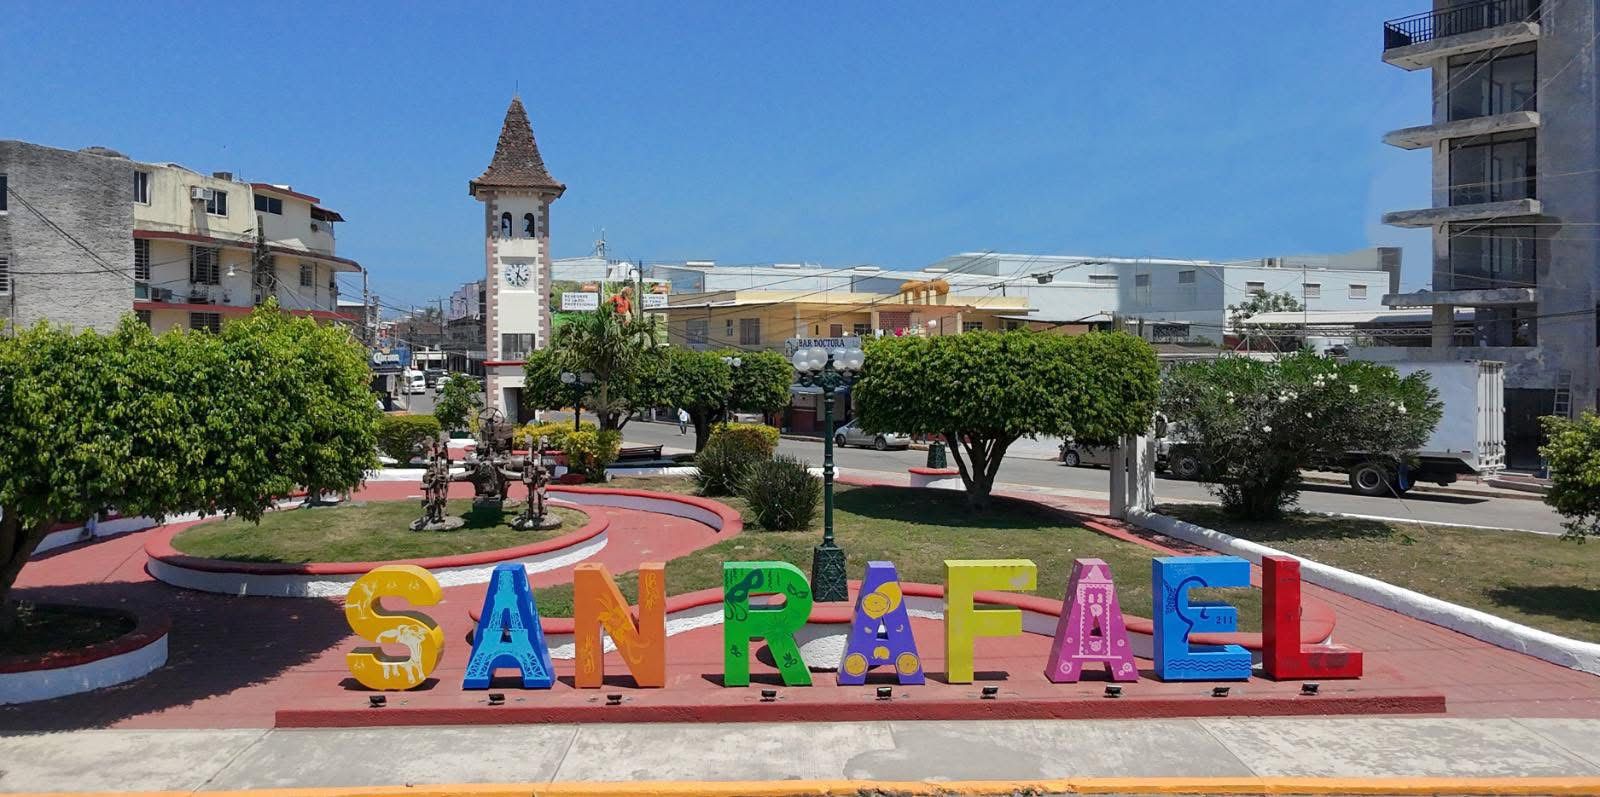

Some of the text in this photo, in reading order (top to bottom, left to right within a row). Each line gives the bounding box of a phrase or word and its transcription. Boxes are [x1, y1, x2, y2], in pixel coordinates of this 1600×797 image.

[798, 338, 845, 347] BAR DOCTORA
[345, 555, 1362, 690] SAN RAFAEL
